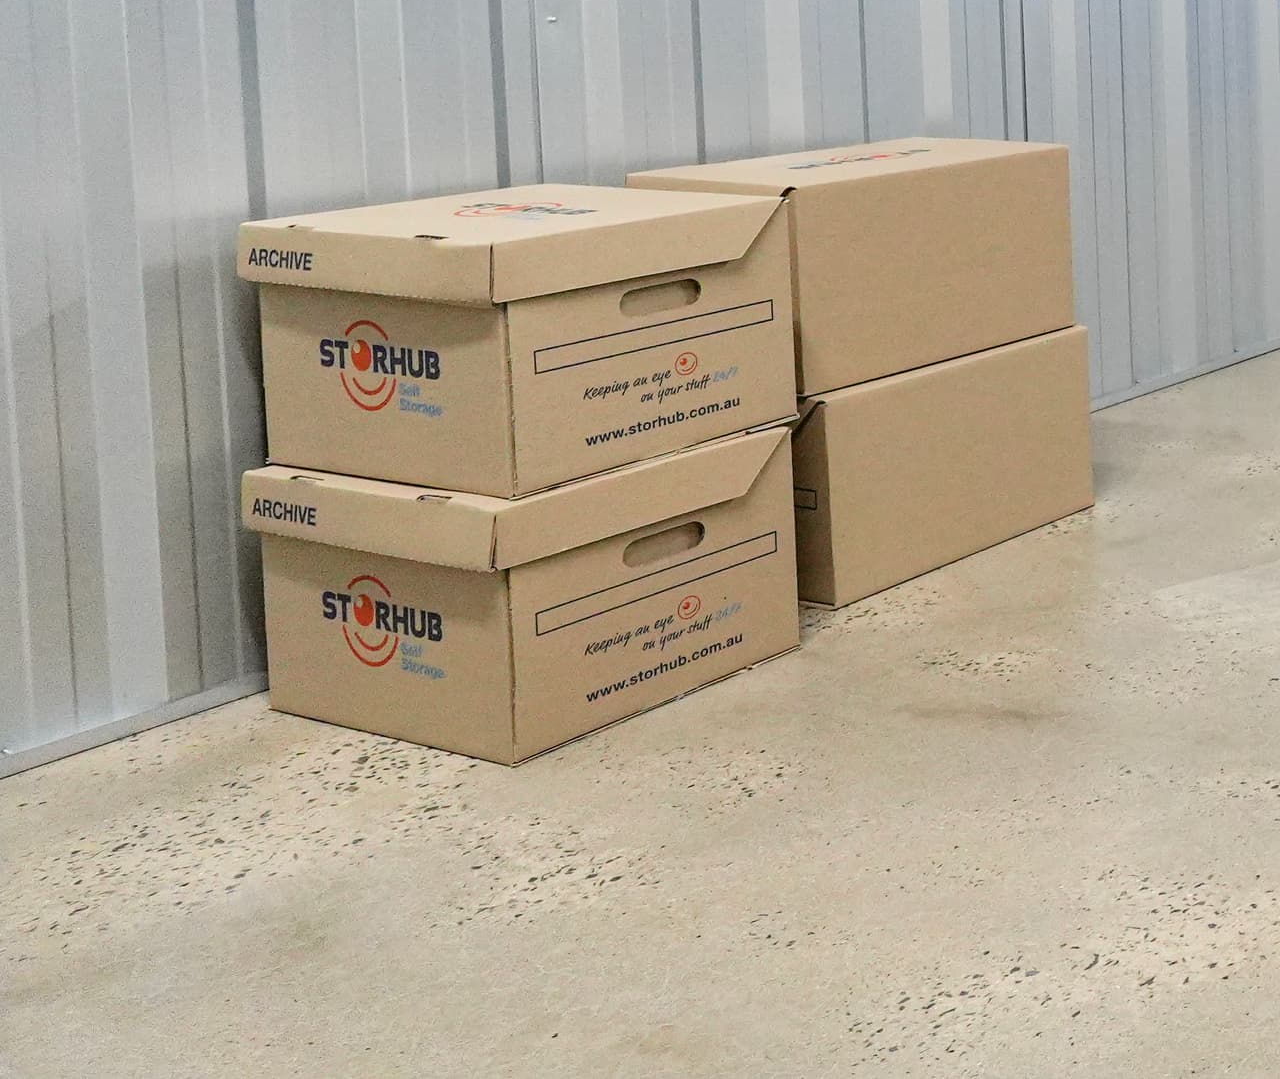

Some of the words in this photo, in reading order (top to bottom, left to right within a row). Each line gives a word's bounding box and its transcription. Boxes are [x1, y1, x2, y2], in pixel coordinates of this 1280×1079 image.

[248, 248, 313, 271] ARCHIVE
[319, 338, 441, 380] STORHUB
[583, 380, 630, 400] Keeping
[633, 377, 648, 388] an
[651, 370, 672, 386] eye
[640, 392, 654, 403] on
[657, 384, 683, 404] your
[686, 373, 711, 393] stuff
[400, 398, 443, 417] Storage
[585, 397, 741, 447] www.storhub.com.au
[252, 498, 317, 526] ARCHIVE
[322, 591, 443, 642] STORHUB
[584, 629, 632, 656] Keeping
[635, 624, 650, 637] an
[654, 615, 674, 632] eye
[642, 641, 656, 651] on
[660, 630, 686, 650] your
[586, 633, 743, 702] www.storhub.com.au
